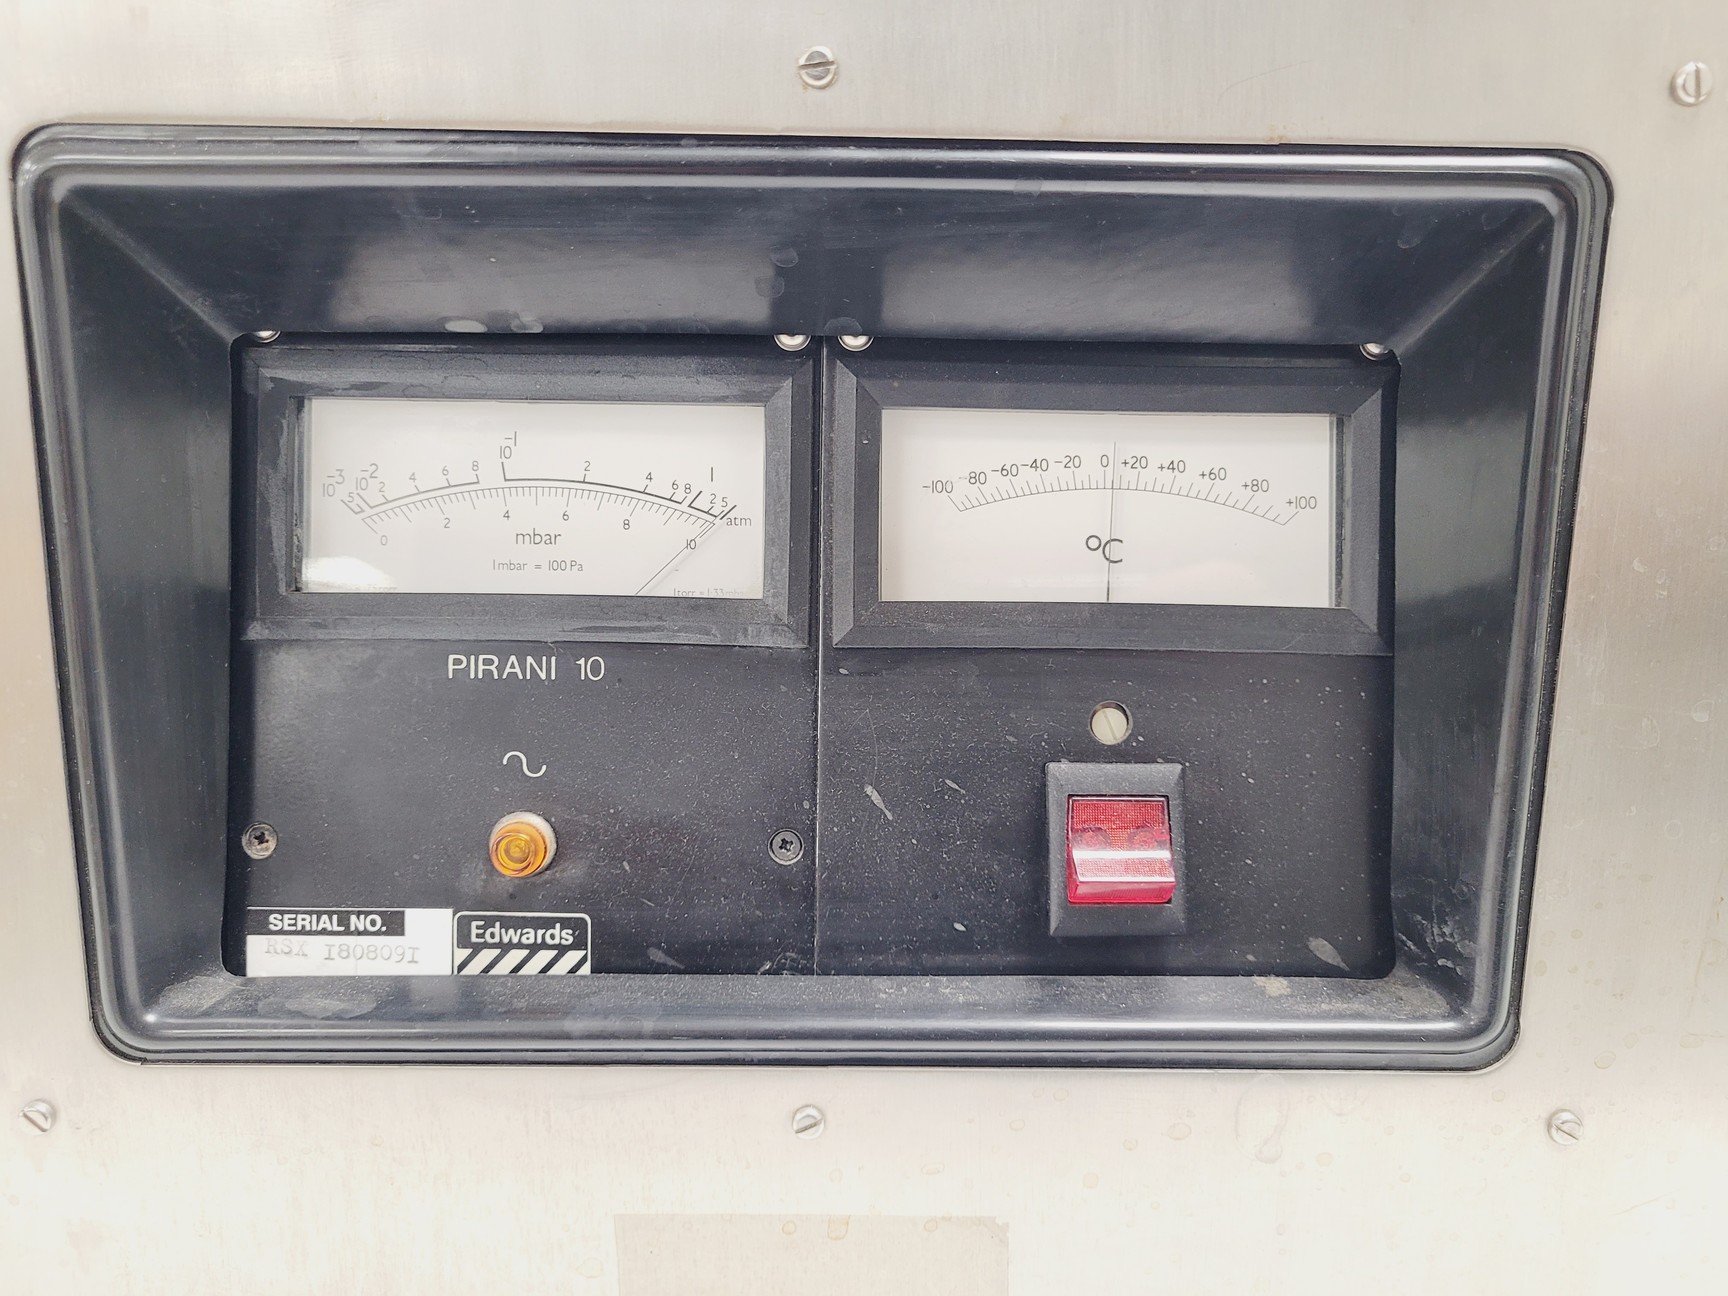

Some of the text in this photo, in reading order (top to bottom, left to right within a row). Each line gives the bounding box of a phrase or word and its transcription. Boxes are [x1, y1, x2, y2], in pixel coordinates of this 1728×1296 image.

[378, 481, 386, 493] 2
[409, 472, 417, 482] 4
[441, 465, 449, 476] 6
[471, 460, 479, 471] 8
[584, 460, 591, 471] 2
[645, 472, 653, 482] 4
[671, 480, 679, 490] 6
[684, 483, 692, 494] 8
[1100, 454, 1109, 468] 0
[1121, 455, 1149, 469] +20
[1157, 459, 1186, 473] +40
[1199, 467, 1227, 481] +60
[1241, 478, 1269, 493] +80
[1285, 495, 1317, 510] +100
[347, 492, 355, 503] 5
[709, 493, 752, 526] 2 5 atm
[380, 510, 696, 550] 0 2 4 6 8 10
[515, 528, 561, 545] mbar
[447, 654, 605, 681] PIRANI 10
[268, 914, 387, 932] SERIAL NO.
[470, 920, 574, 946] Edwards
